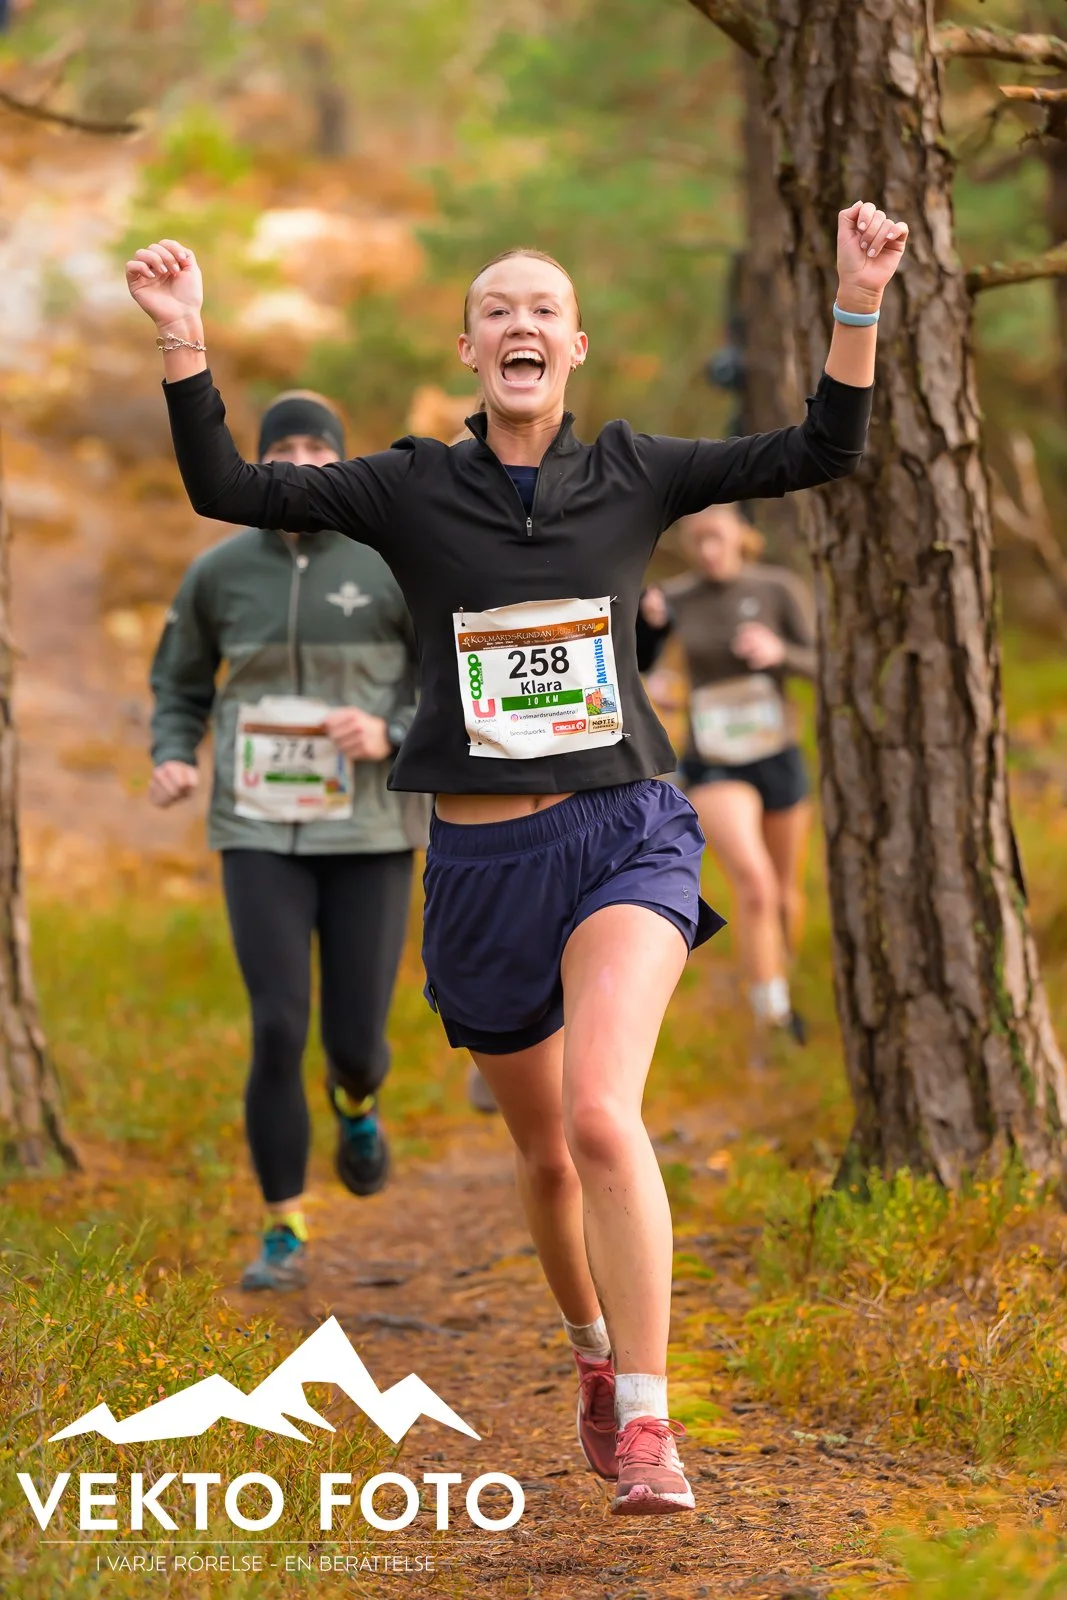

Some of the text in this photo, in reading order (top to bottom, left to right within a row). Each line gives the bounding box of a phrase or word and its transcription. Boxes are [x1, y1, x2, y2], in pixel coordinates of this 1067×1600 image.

[467, 653, 482, 700] coop
[508, 646, 570, 679] 258
[594, 638, 608, 684] Aktivitus
[521, 680, 562, 695] Klara
[528, 694, 559, 706] 10 KM
